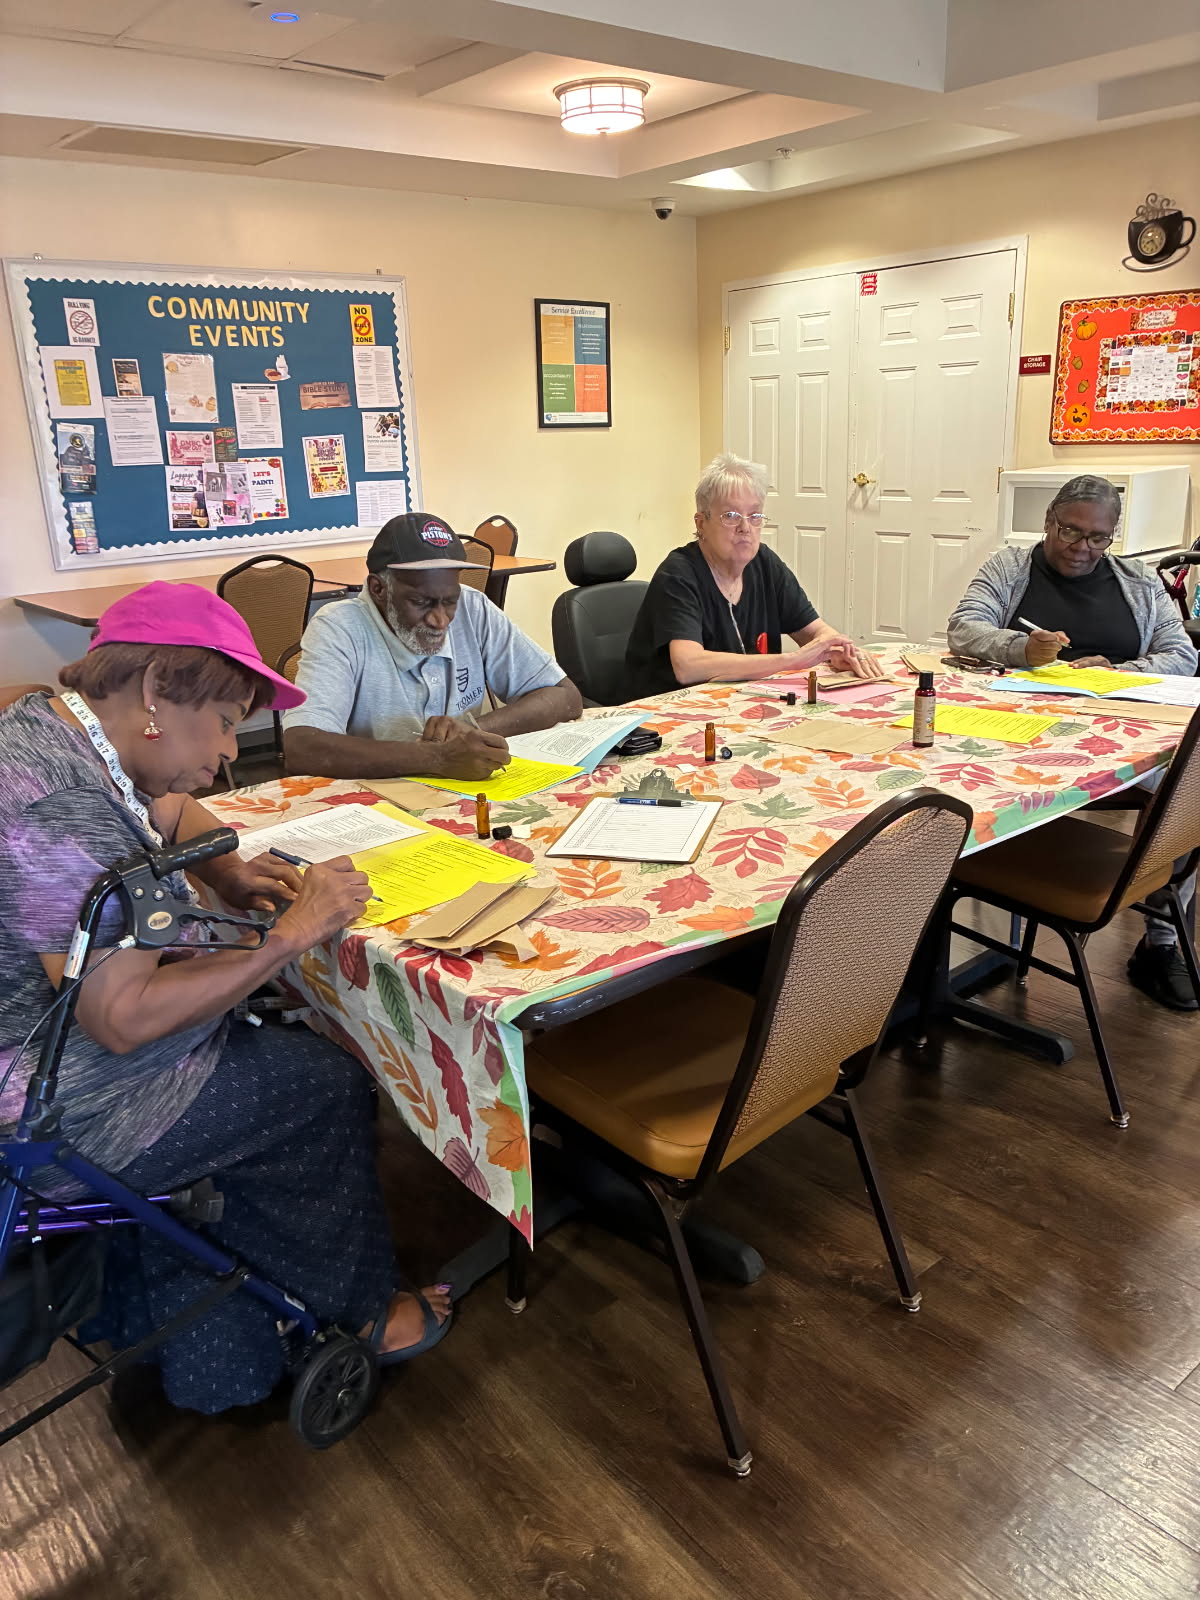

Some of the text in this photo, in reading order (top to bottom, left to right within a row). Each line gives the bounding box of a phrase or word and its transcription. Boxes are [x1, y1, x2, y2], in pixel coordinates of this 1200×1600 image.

[147, 295, 310, 324] COMMUNITY
[353, 307, 368, 315] NO
[551, 306, 570, 315] Service
[188, 324, 286, 348] EVENTS
[323, 385, 345, 393] STUDY
[420, 530, 453, 541] PISTONS
[87, 724, 98, 737] 36
